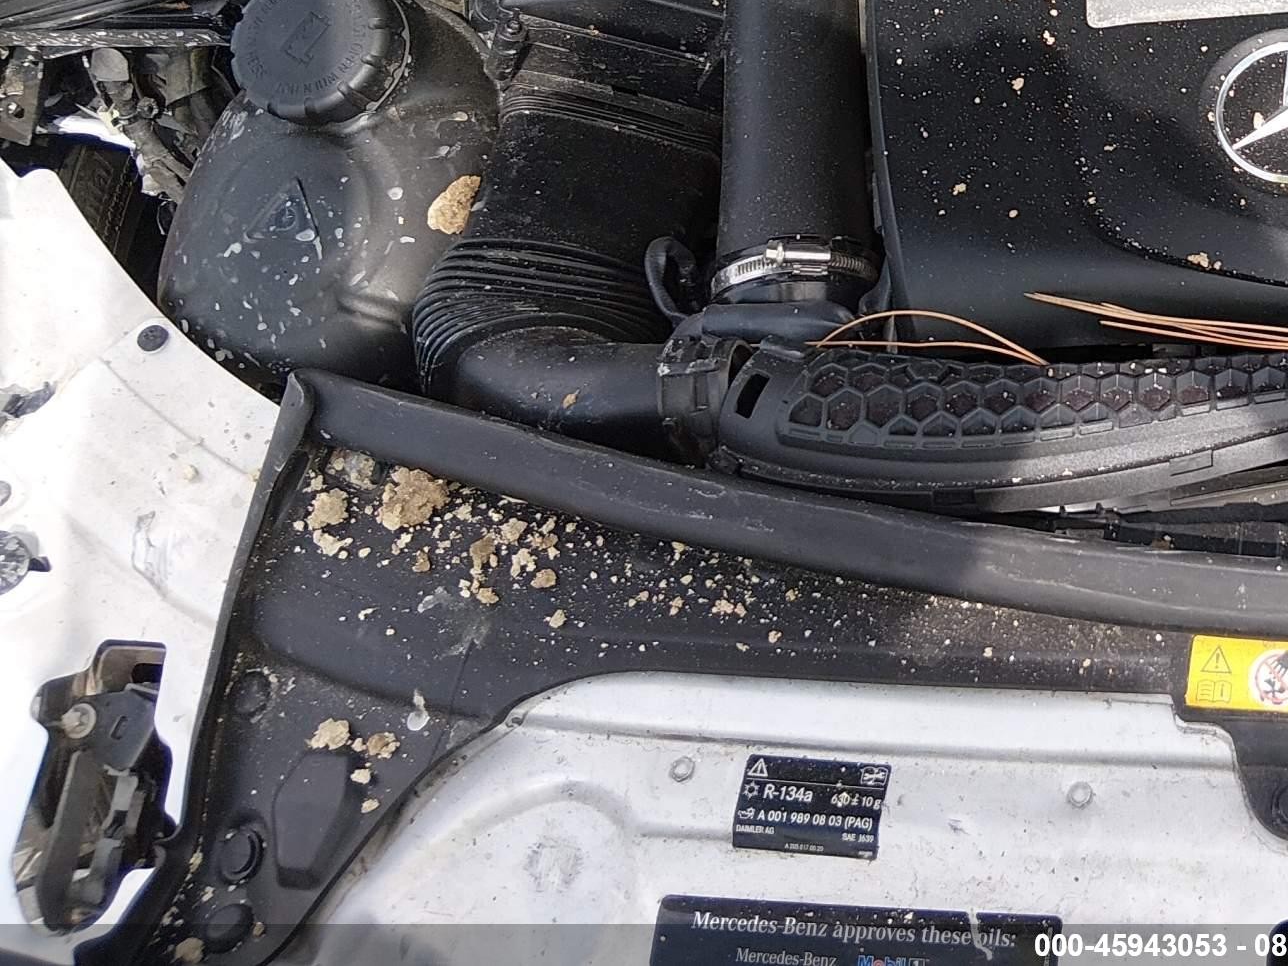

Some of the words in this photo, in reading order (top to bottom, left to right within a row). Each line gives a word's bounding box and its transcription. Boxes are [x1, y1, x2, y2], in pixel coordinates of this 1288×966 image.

[763, 783, 813, 803] R-134a
[757, 810, 765, 821] A
[768, 811, 786, 823] 001
[791, 813, 810, 825] 989
[828, 816, 842, 827] 03
[845, 817, 873, 832] (PAG)
[691, 911, 828, 937] Mercedes-Benz
[832, 920, 916, 944] approves
[922, 925, 972, 945] these
[978, 927, 1016, 947] oils:
[735, 947, 837, 966] Mercedes-Benz
